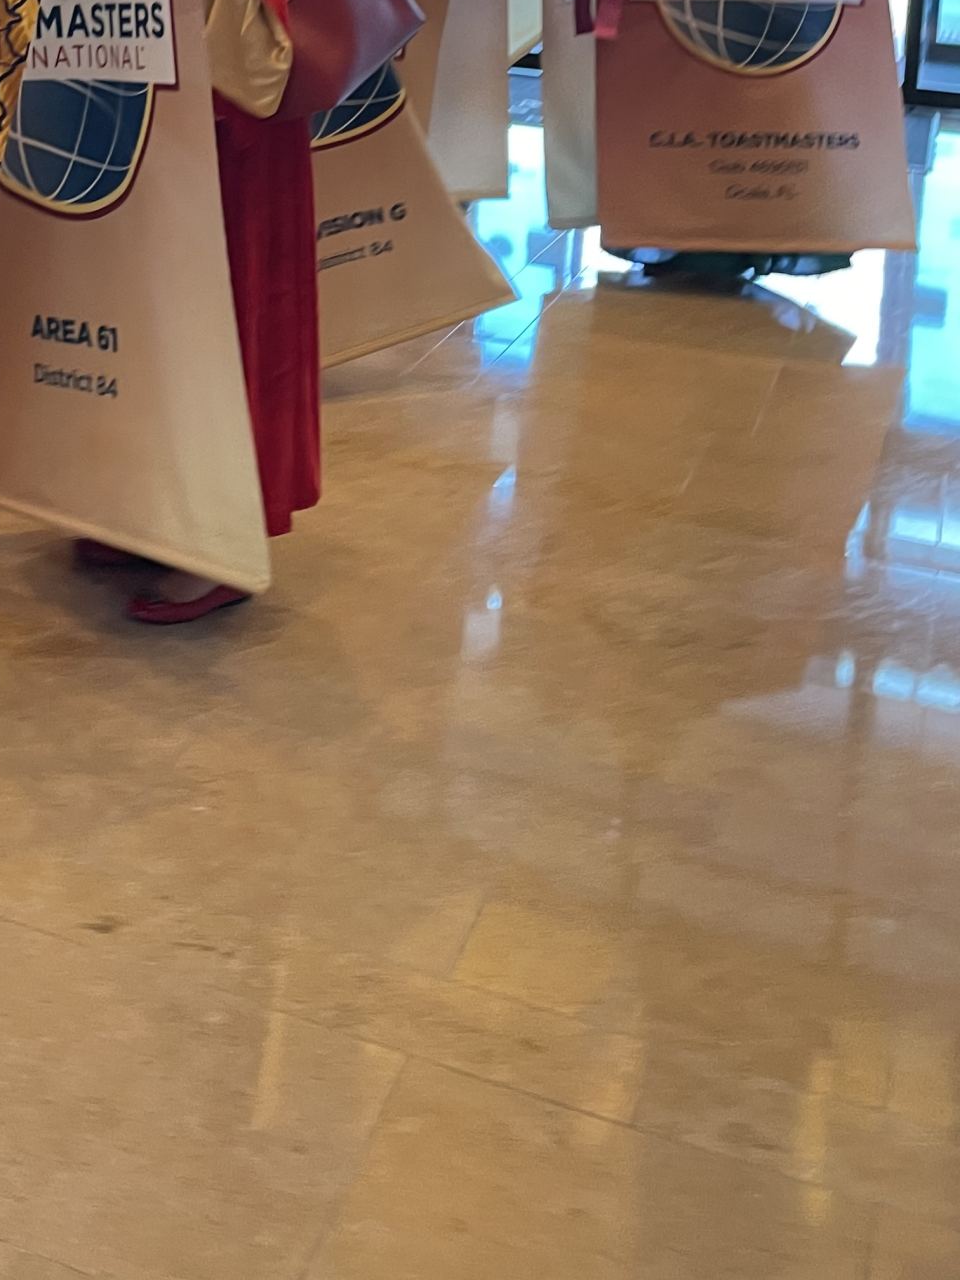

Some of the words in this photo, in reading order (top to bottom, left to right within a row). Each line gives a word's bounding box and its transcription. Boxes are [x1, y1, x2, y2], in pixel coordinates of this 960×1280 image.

[35, 1, 166, 39] MASTERS
[31, 43, 147, 70] NATIONAL
[31, 313, 93, 348] AREA
[97, 324, 119, 354] 61
